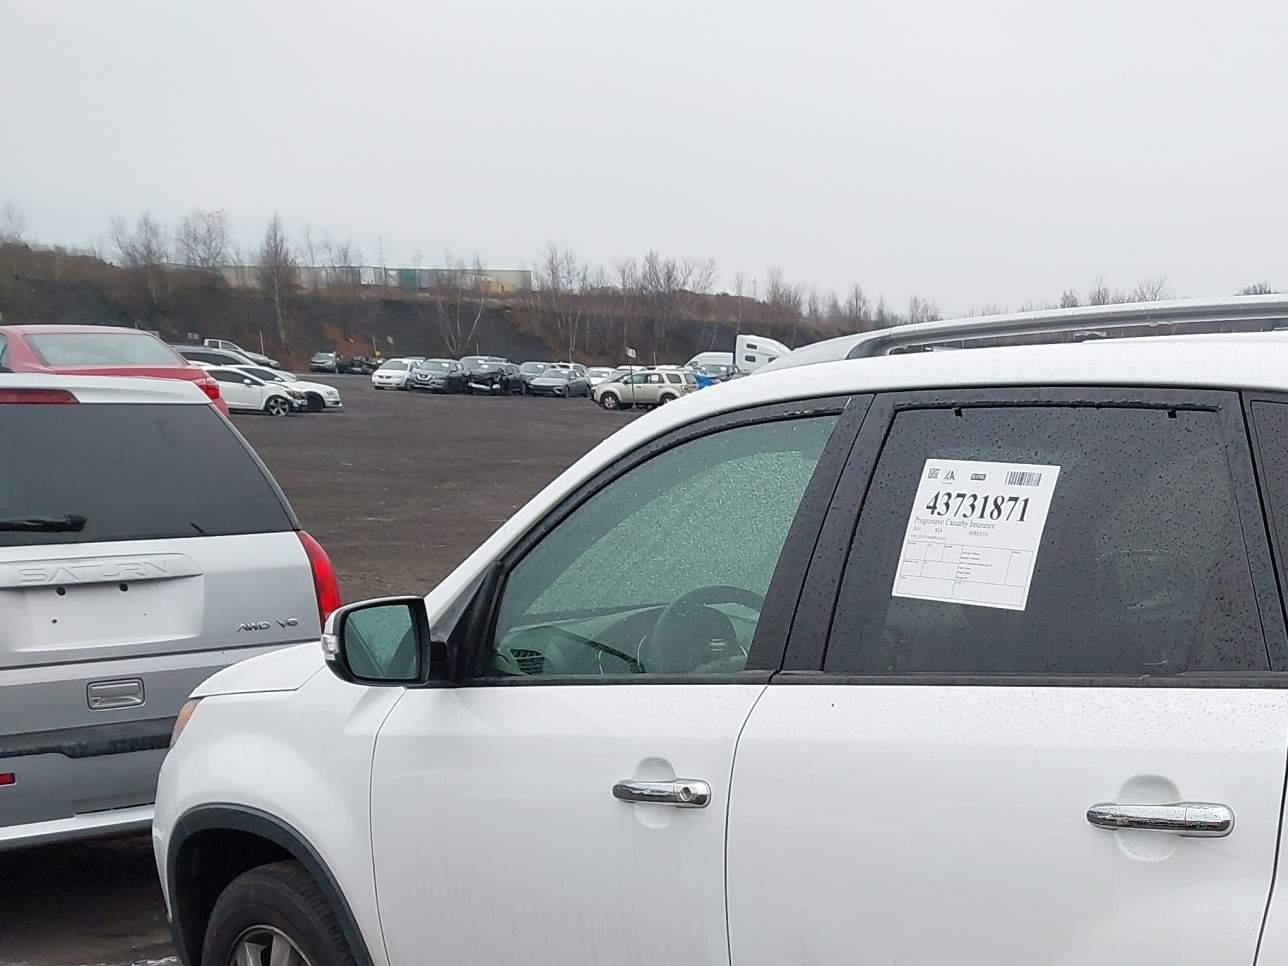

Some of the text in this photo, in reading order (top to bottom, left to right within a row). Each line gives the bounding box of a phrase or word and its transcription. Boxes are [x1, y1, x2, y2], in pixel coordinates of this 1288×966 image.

[925, 491, 1029, 522] 43731871
[914, 516, 996, 530] Progressive Casualty Insurance
[18, 560, 168, 583] SATURN
[236, 618, 299, 633] AWD V6
